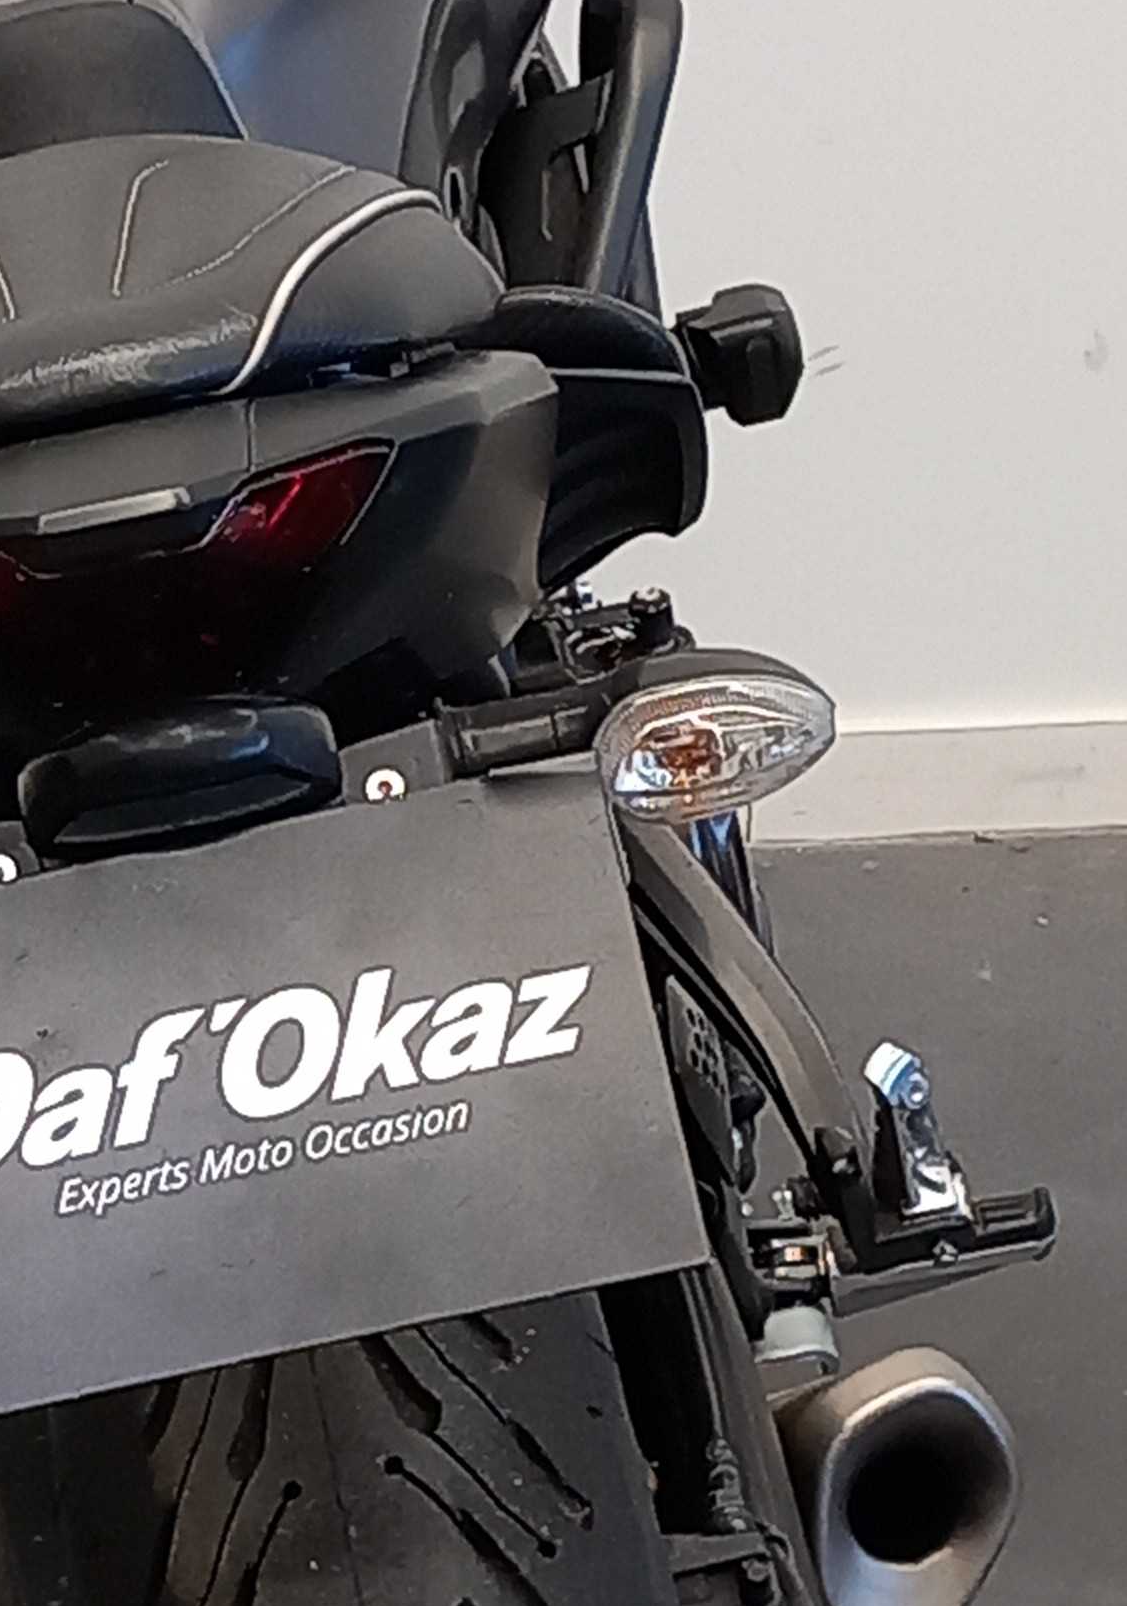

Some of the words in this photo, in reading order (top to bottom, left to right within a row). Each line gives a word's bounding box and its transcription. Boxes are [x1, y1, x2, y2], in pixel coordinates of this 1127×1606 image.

[58, 1160, 190, 1216] Experts
[198, 1139, 294, 1184] Moto
[304, 1100, 469, 1161] Occasion
